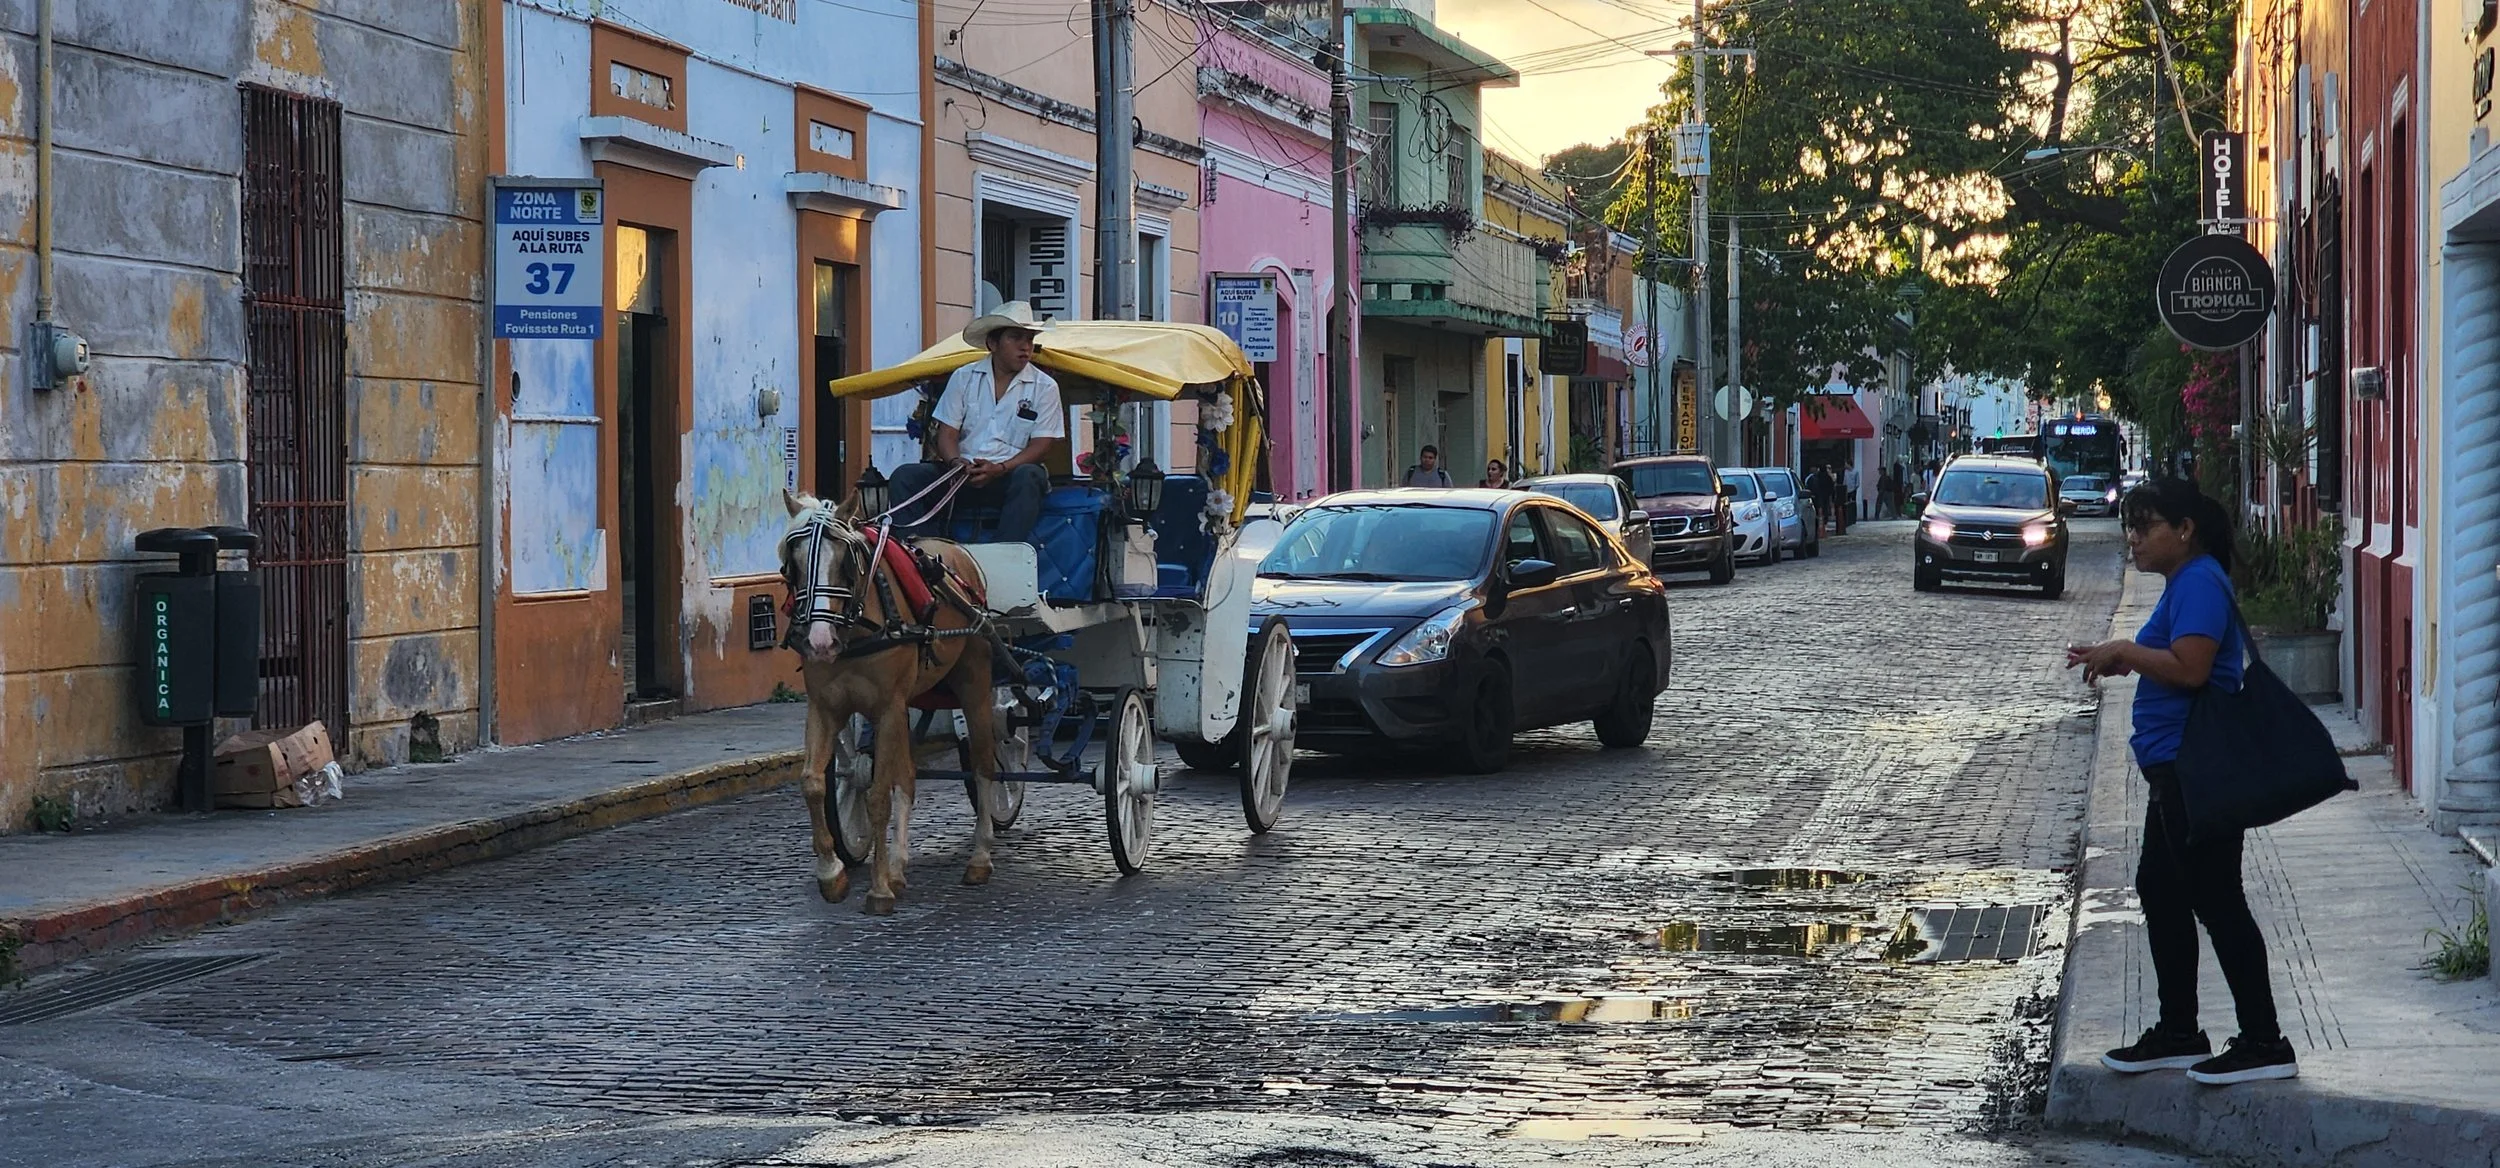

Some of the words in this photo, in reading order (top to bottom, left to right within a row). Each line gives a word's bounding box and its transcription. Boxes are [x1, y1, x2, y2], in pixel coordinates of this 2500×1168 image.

[2213, 138, 2231, 221] HOTEL
[513, 192, 556, 205] ZONA
[510, 206, 562, 219] NORTE
[512, 228, 544, 241] AQUÍ
[546, 231, 590, 242] SUBES
[518, 243, 529, 253] A
[530, 243, 547, 253] LA
[549, 243, 584, 254] RUTA
[525, 262, 575, 294] 37
[1029, 227, 1064, 322] ESTAC
[2192, 276, 2241, 292] BIANCA
[2179, 294, 2256, 309] TROPICAL
[520, 309, 578, 319] Pensiones
[1220, 311, 1239, 326] 10
[505, 323, 559, 334] Fovissste
[560, 324, 587, 334] Ruta
[588, 324, 595, 334] 1
[156, 601, 169, 709] ORGANICA
